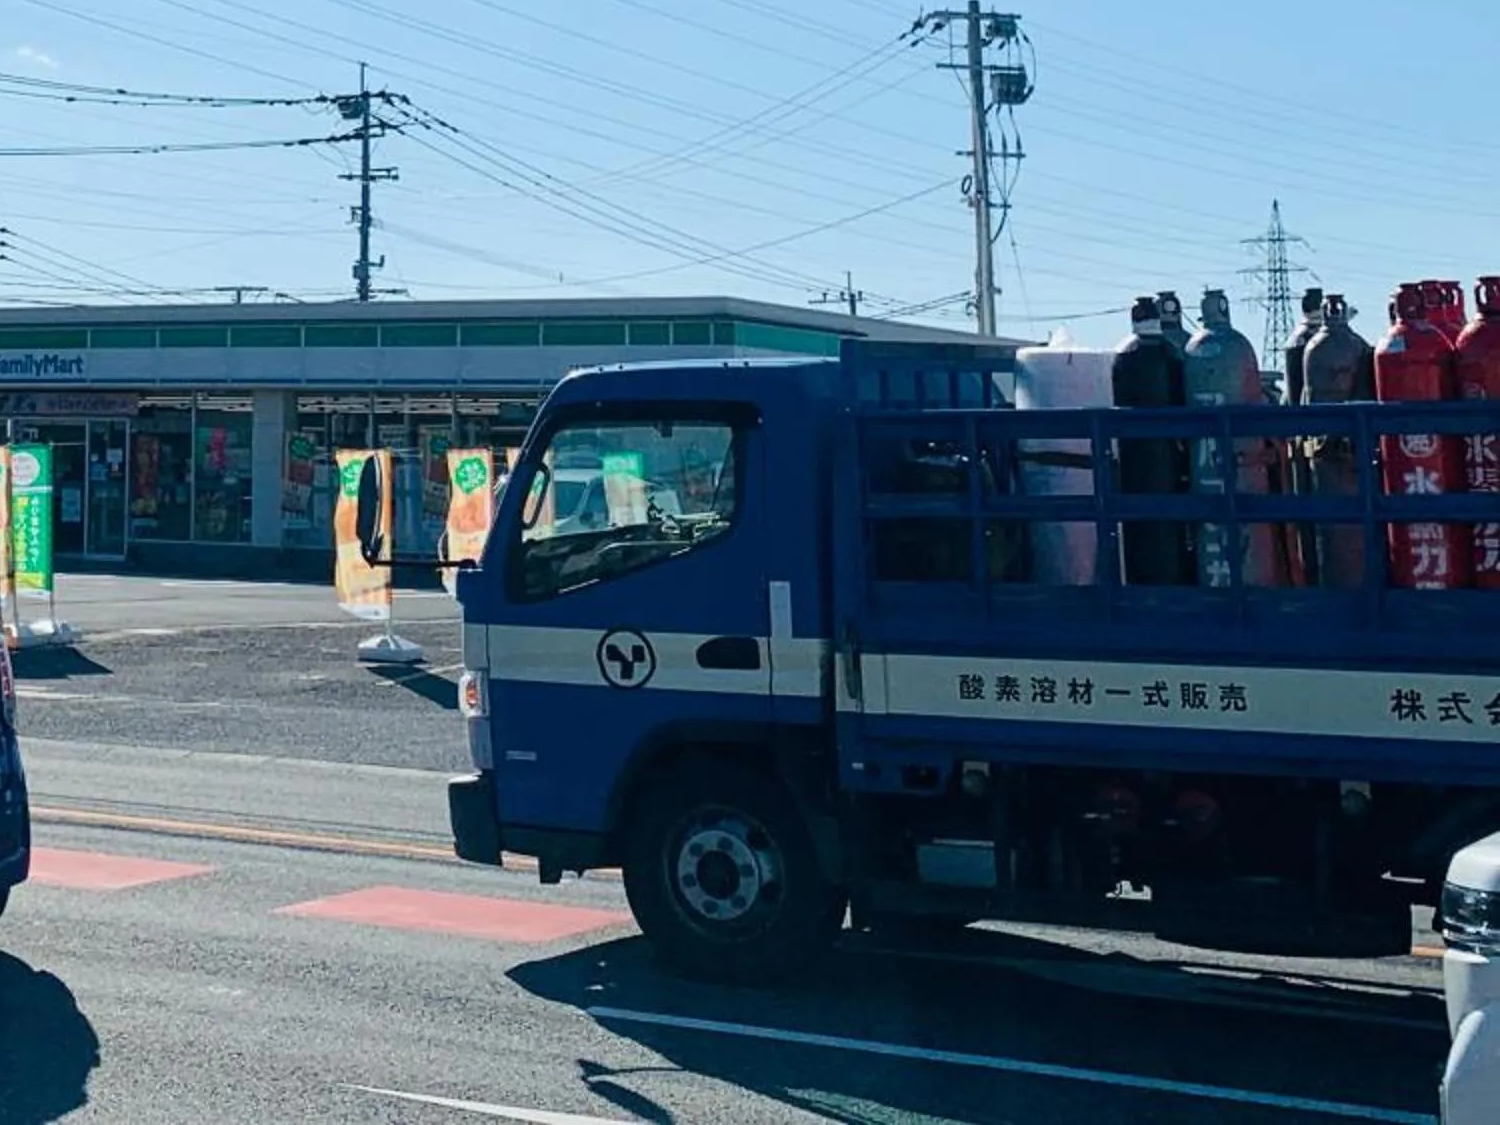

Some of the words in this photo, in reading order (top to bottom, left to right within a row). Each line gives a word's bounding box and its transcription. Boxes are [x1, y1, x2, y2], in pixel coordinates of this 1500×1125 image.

[958, 674, 1248, 712] 酸素溶材一式販売
